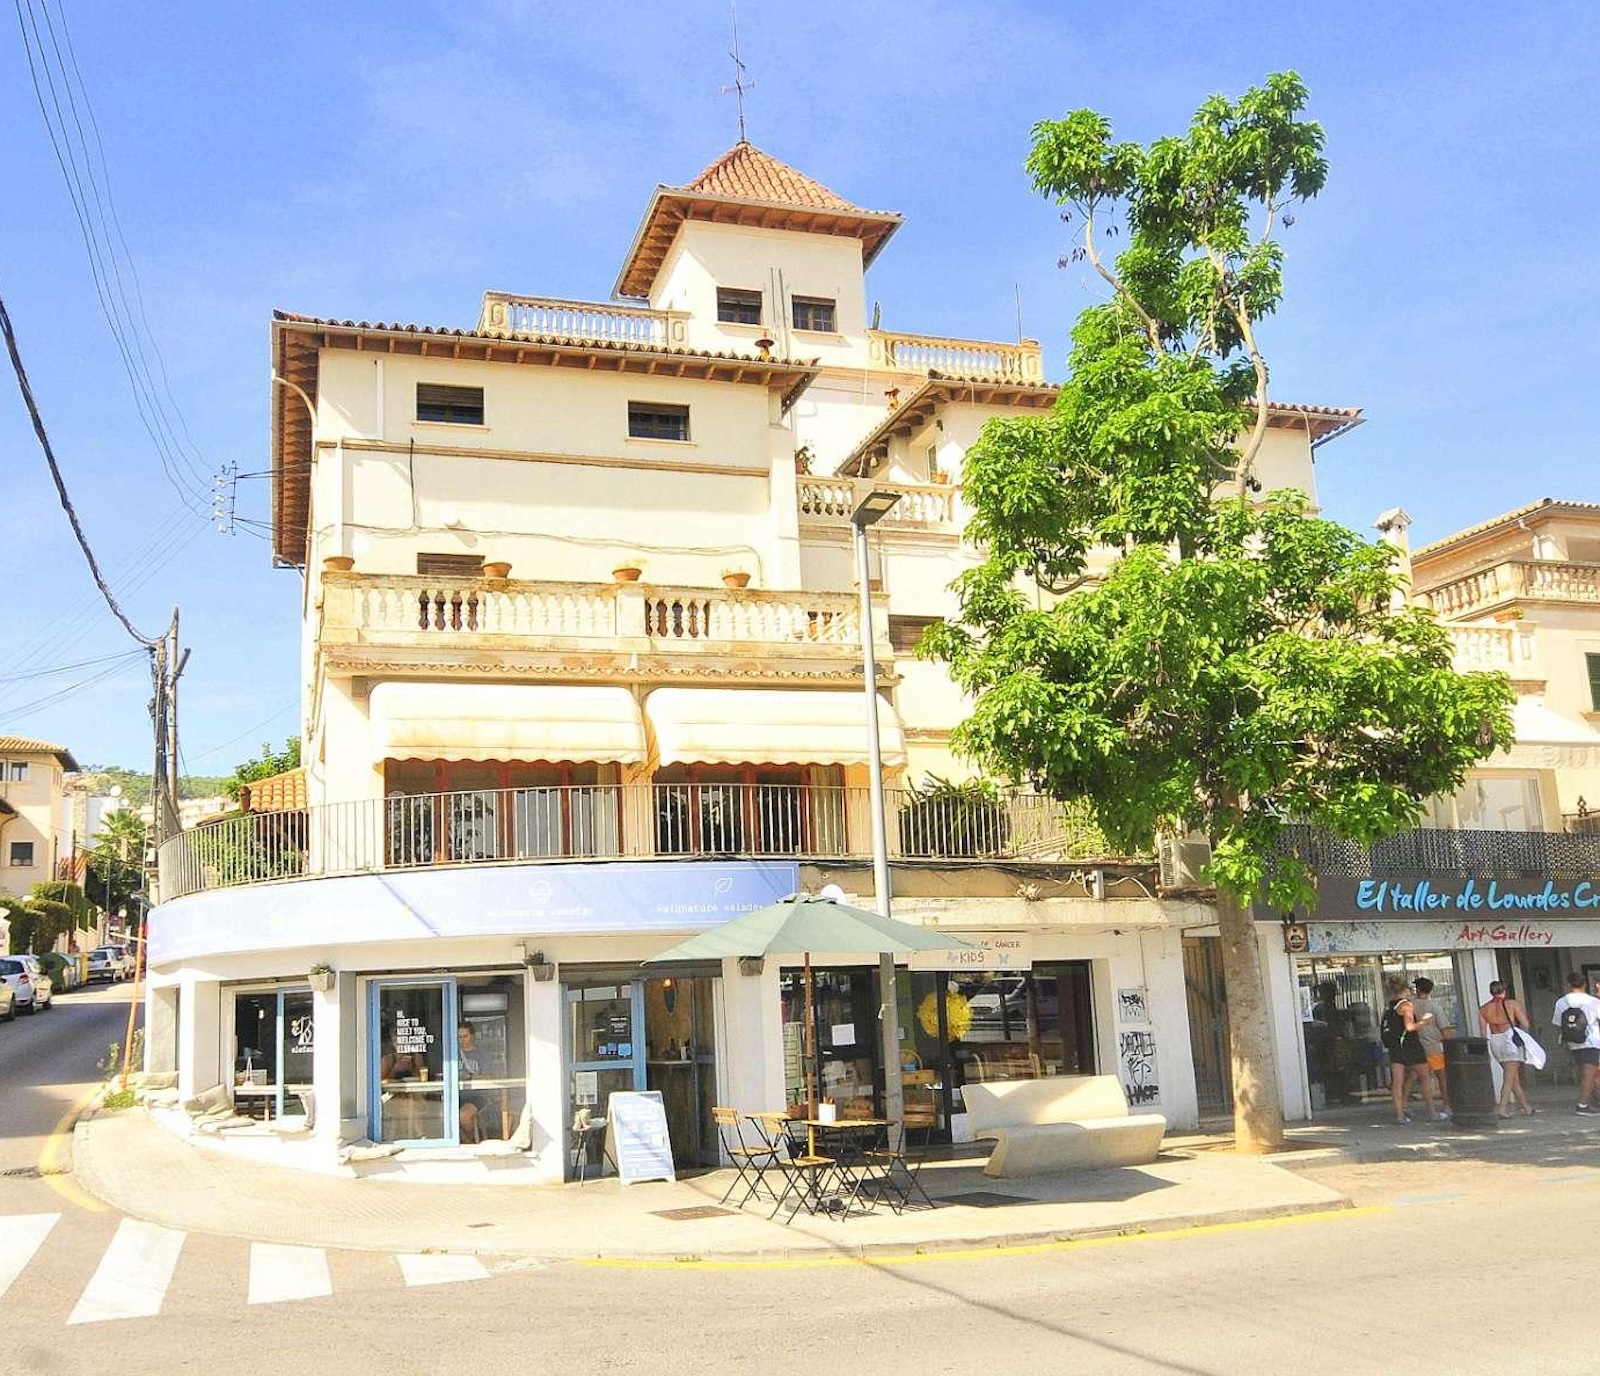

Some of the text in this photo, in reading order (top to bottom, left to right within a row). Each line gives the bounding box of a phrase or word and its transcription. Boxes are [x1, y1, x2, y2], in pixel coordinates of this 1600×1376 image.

[1357, 880, 1387, 912] El
[1390, 880, 1452, 912] taller
[1456, 879, 1484, 911] de
[1487, 879, 1570, 911] Lourdes
[1457, 923, 1554, 945] Art Gallery
[959, 951, 985, 964] KIDS
